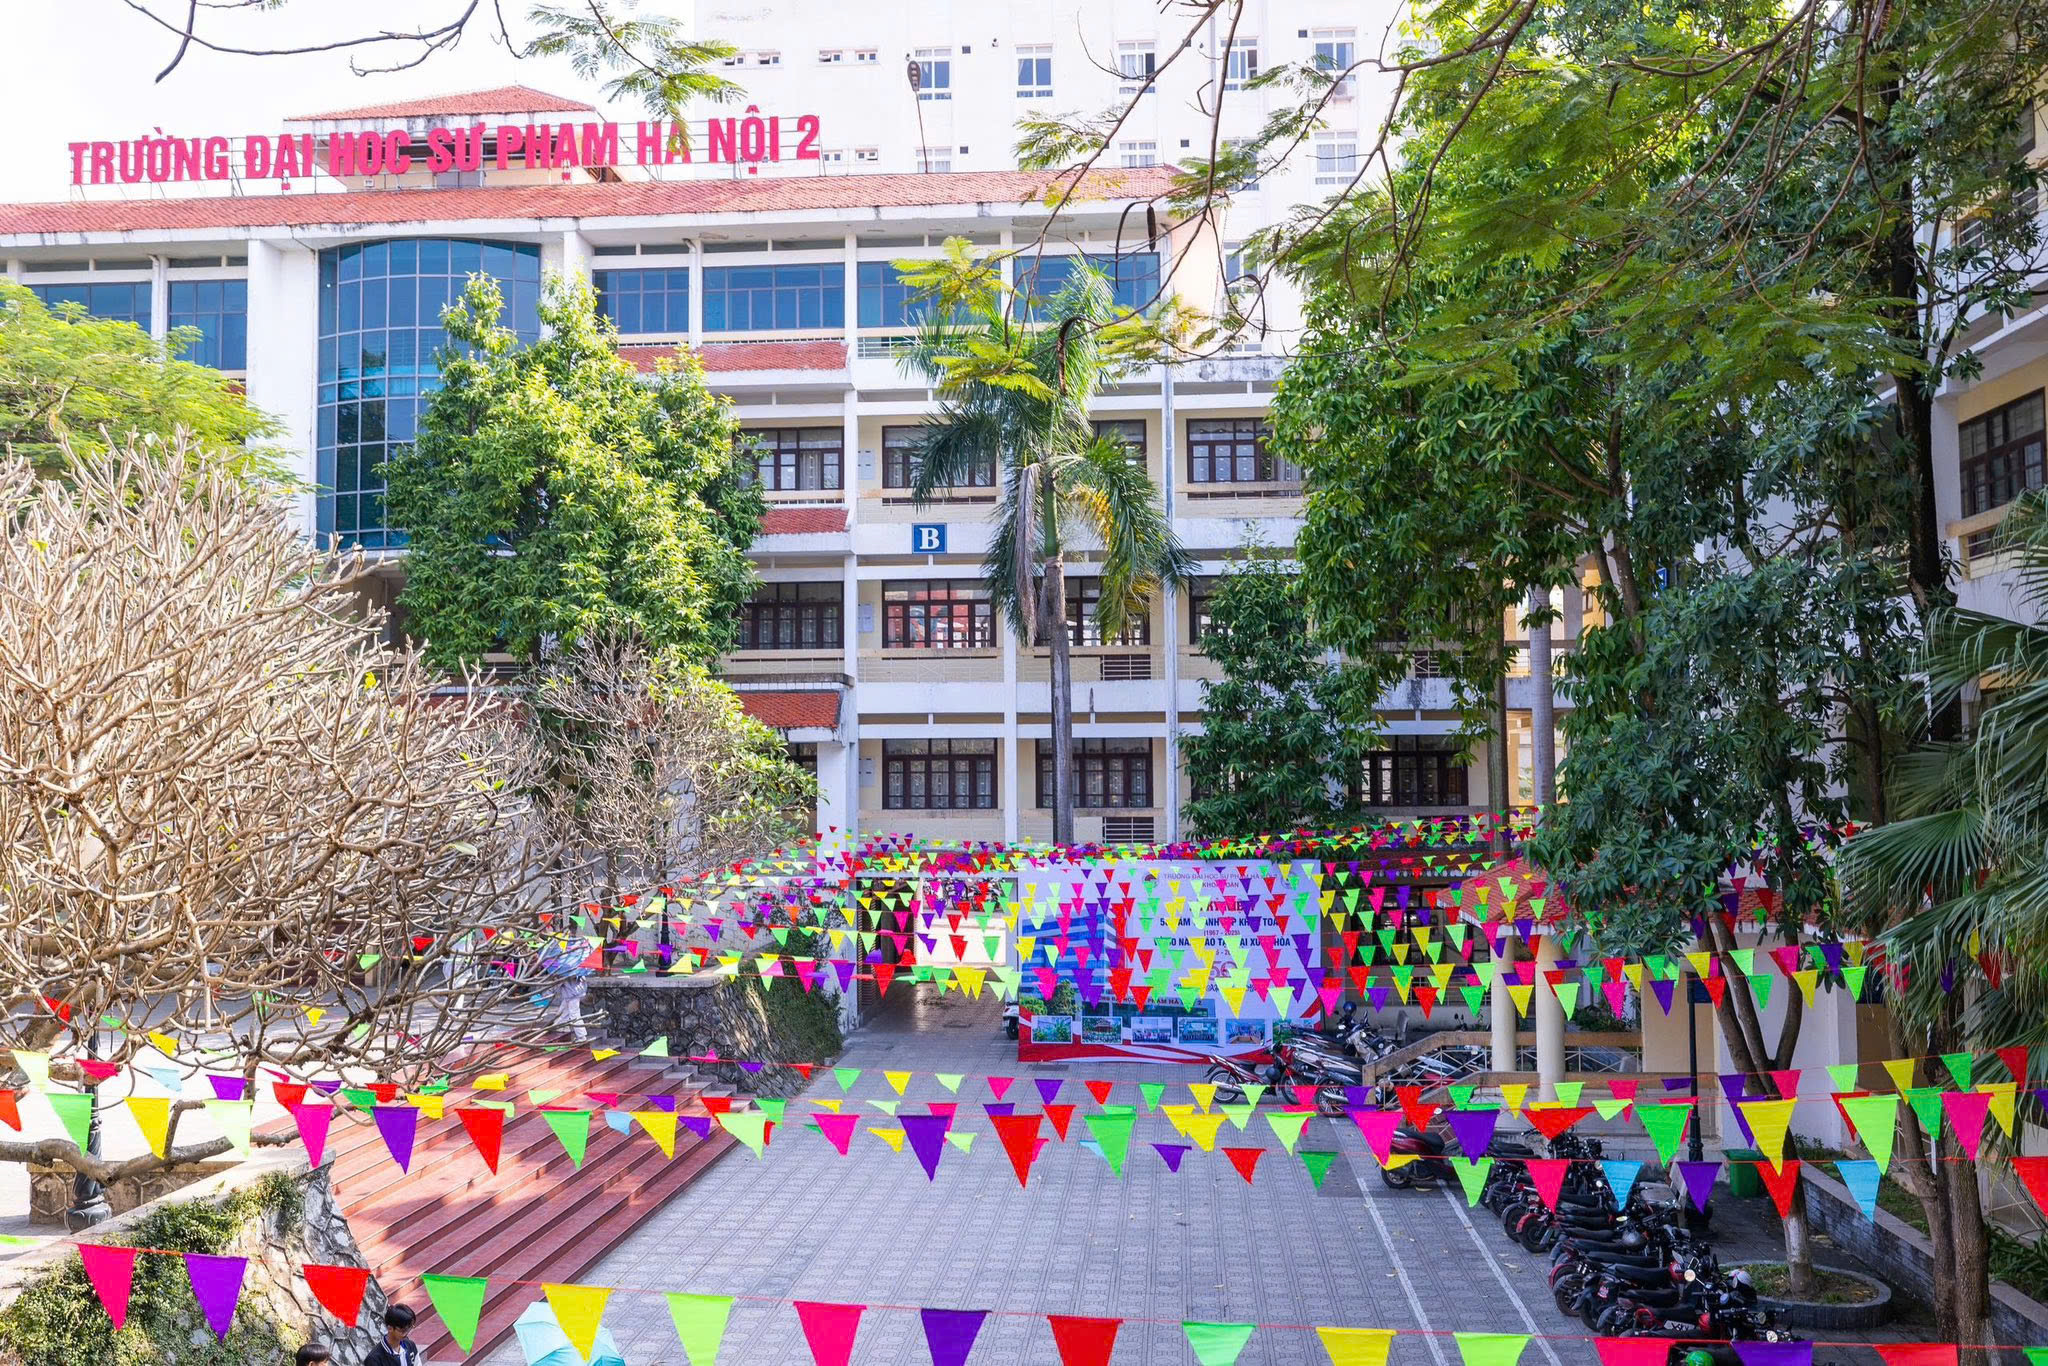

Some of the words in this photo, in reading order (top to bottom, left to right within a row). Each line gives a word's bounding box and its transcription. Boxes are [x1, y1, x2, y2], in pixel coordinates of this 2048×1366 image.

[68, 127, 229, 185] TRƯỜNG
[244, 133, 313, 191] ĐẠI
[426, 122, 486, 174] SƯ
[497, 122, 619, 184] PHẠM
[708, 105, 779, 175] NỘI
[796, 115, 820, 160] 2
[919, 527, 940, 550] B
